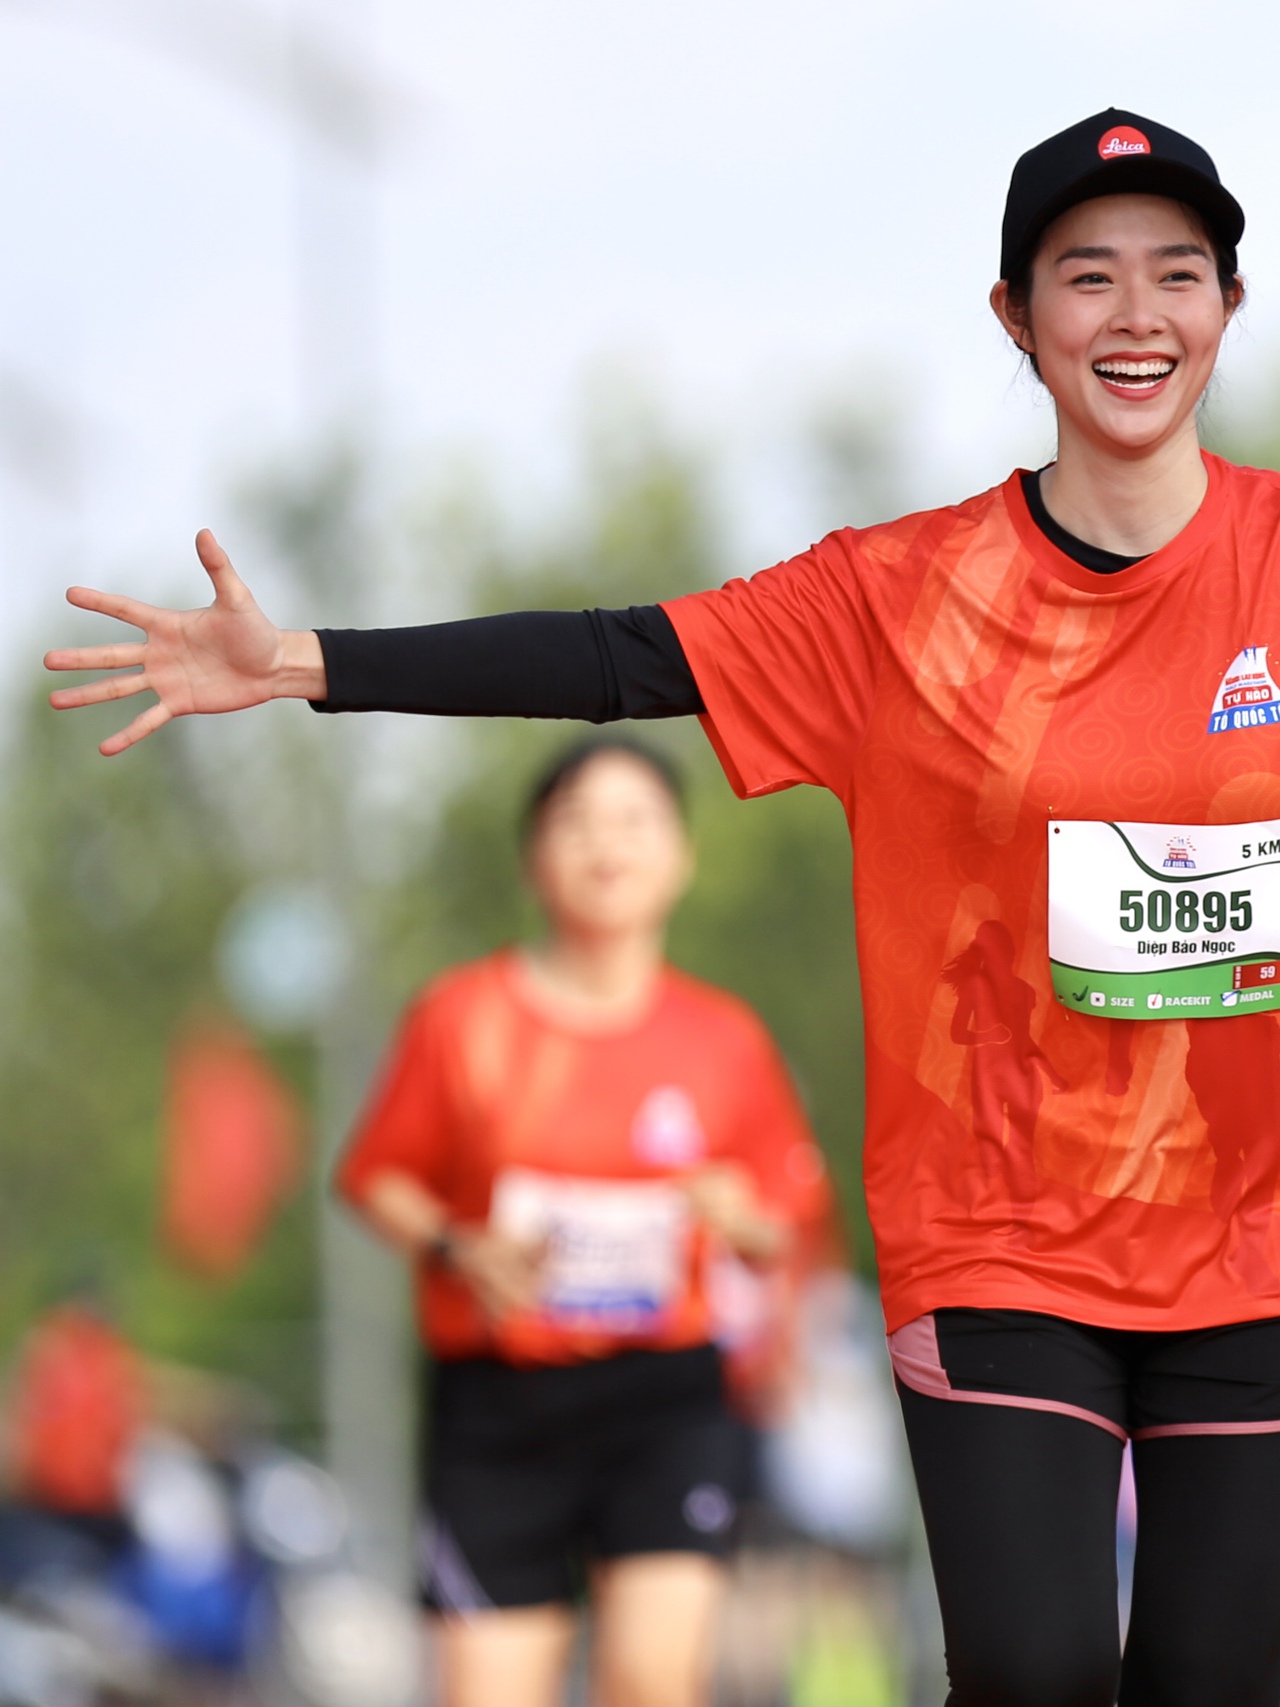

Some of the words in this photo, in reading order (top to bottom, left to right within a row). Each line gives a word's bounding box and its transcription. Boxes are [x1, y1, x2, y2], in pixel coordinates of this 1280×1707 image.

[1103, 138, 1145, 155] Leica
[1242, 844, 1251, 859] 5
[1120, 890, 1253, 933] 50895
[1137, 940, 1167, 957] Diệp
[1201, 939, 1236, 956] Ngọc
[1260, 965, 1276, 979] 59
[1110, 997, 1135, 1007] SIZE
[1165, 996, 1211, 1006] RACEKIT
[1240, 990, 1275, 1003] MEDAL
